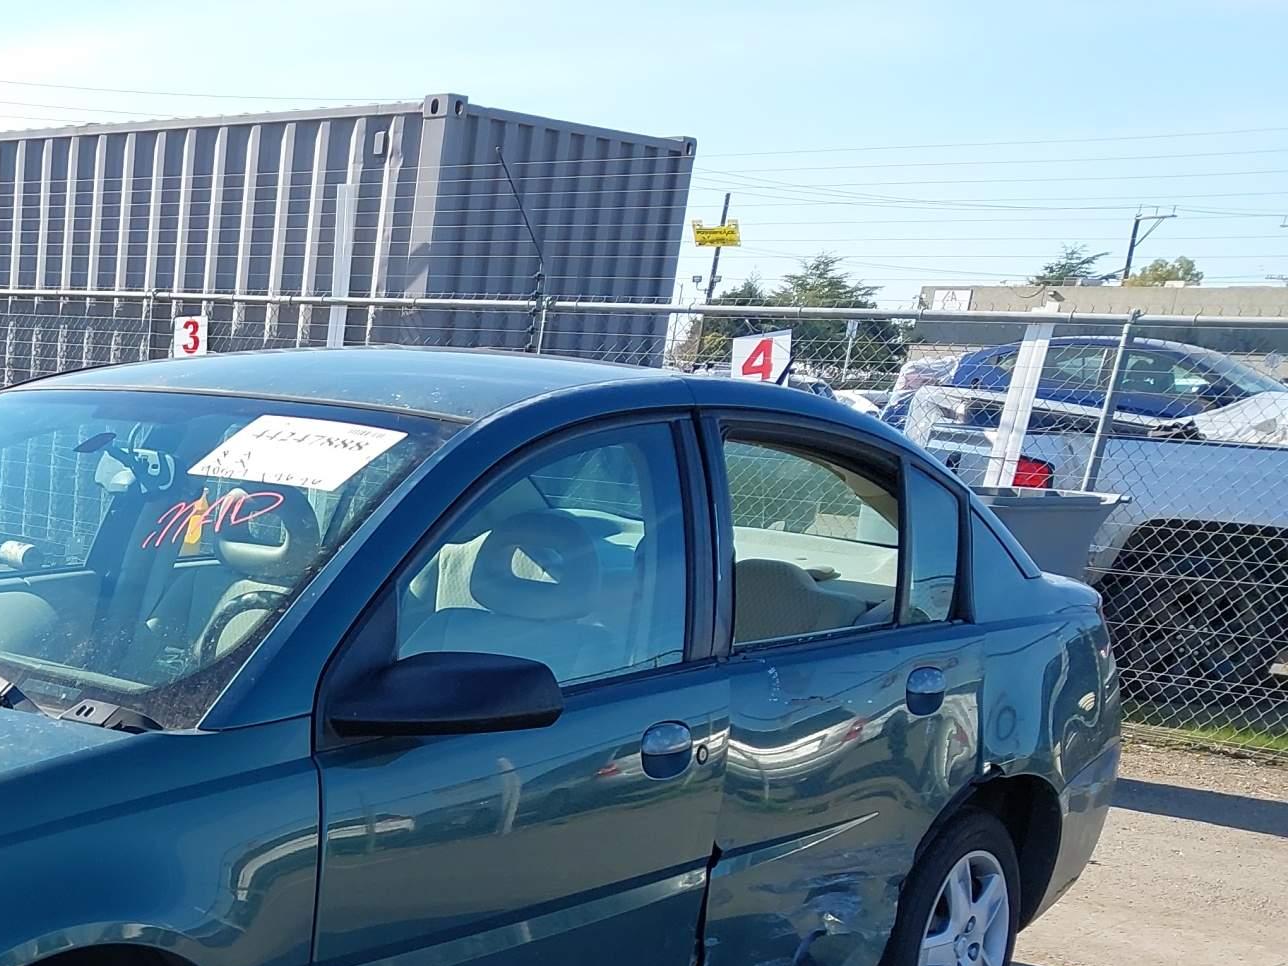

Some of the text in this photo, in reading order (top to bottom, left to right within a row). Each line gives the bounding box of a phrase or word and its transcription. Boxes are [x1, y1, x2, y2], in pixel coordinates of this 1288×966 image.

[182, 319, 200, 354] 3
[742, 337, 773, 380] 4
[252, 428, 371, 452] 44247888
